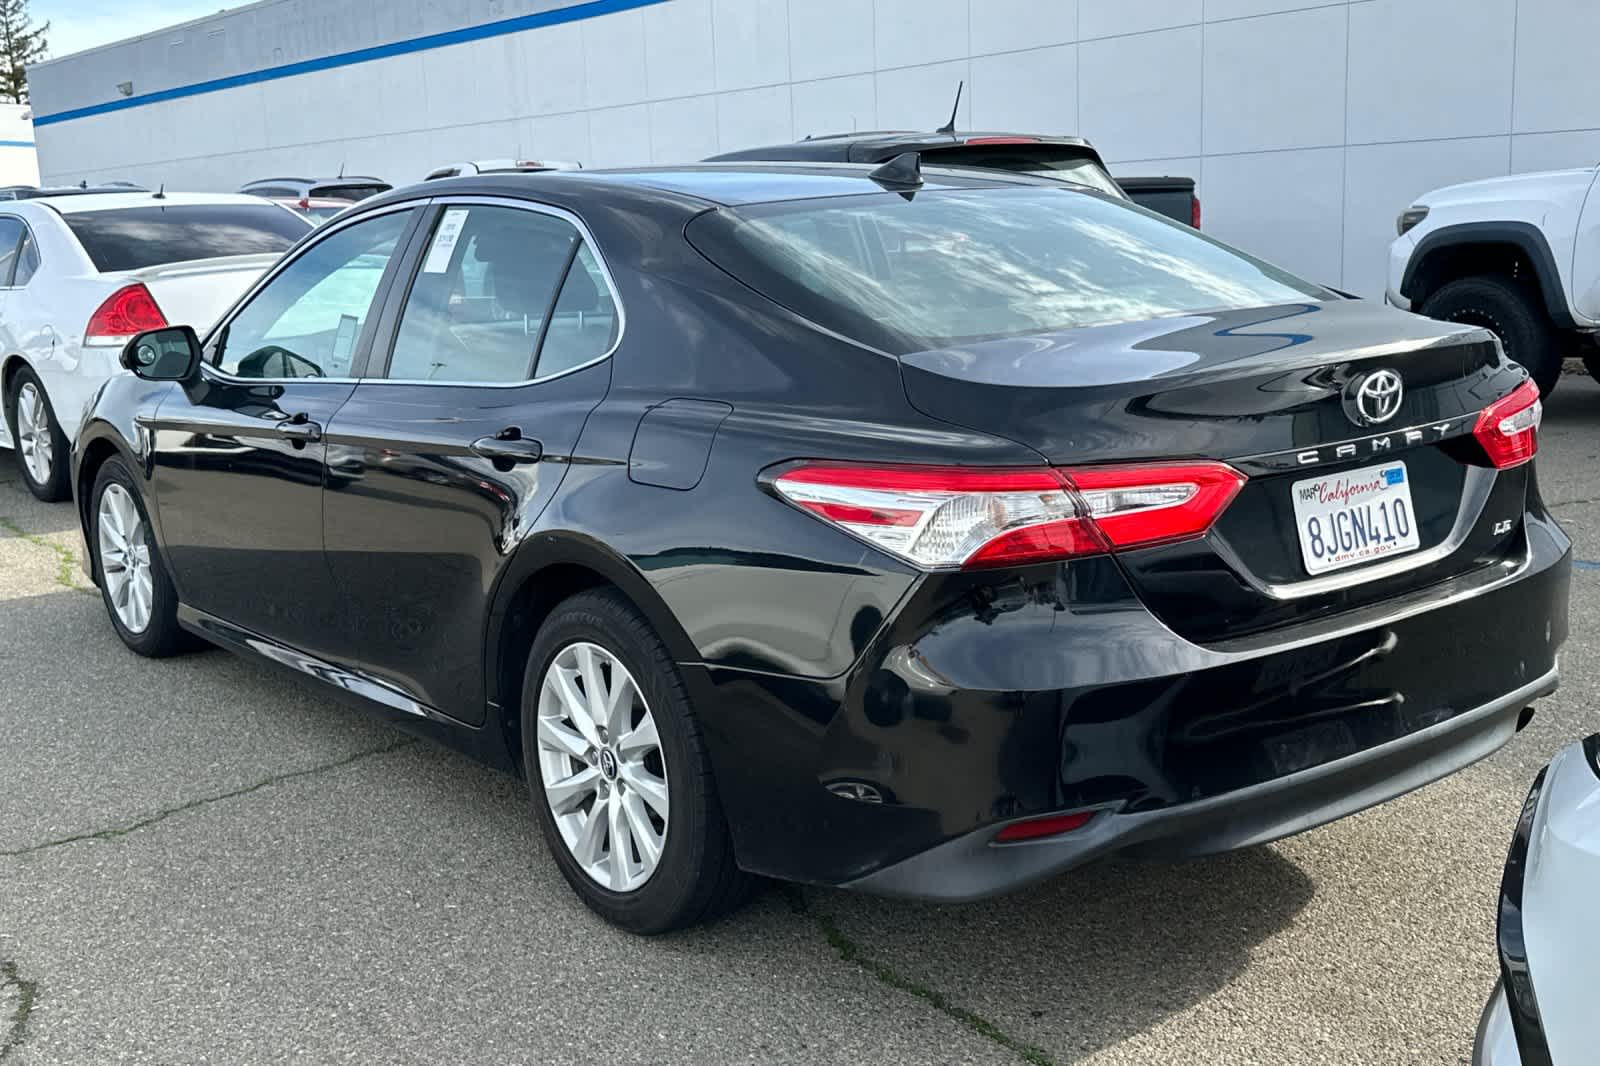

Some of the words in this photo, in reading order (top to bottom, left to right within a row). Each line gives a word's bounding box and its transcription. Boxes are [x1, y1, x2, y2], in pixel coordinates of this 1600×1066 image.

[1297, 423, 1450, 464] CAMRY
[1299, 484, 1317, 502] MAR
[1319, 478, 1386, 505] California
[1308, 498, 1410, 558] 8JGN410
[1334, 543, 1392, 562] dmv.ca.gov
